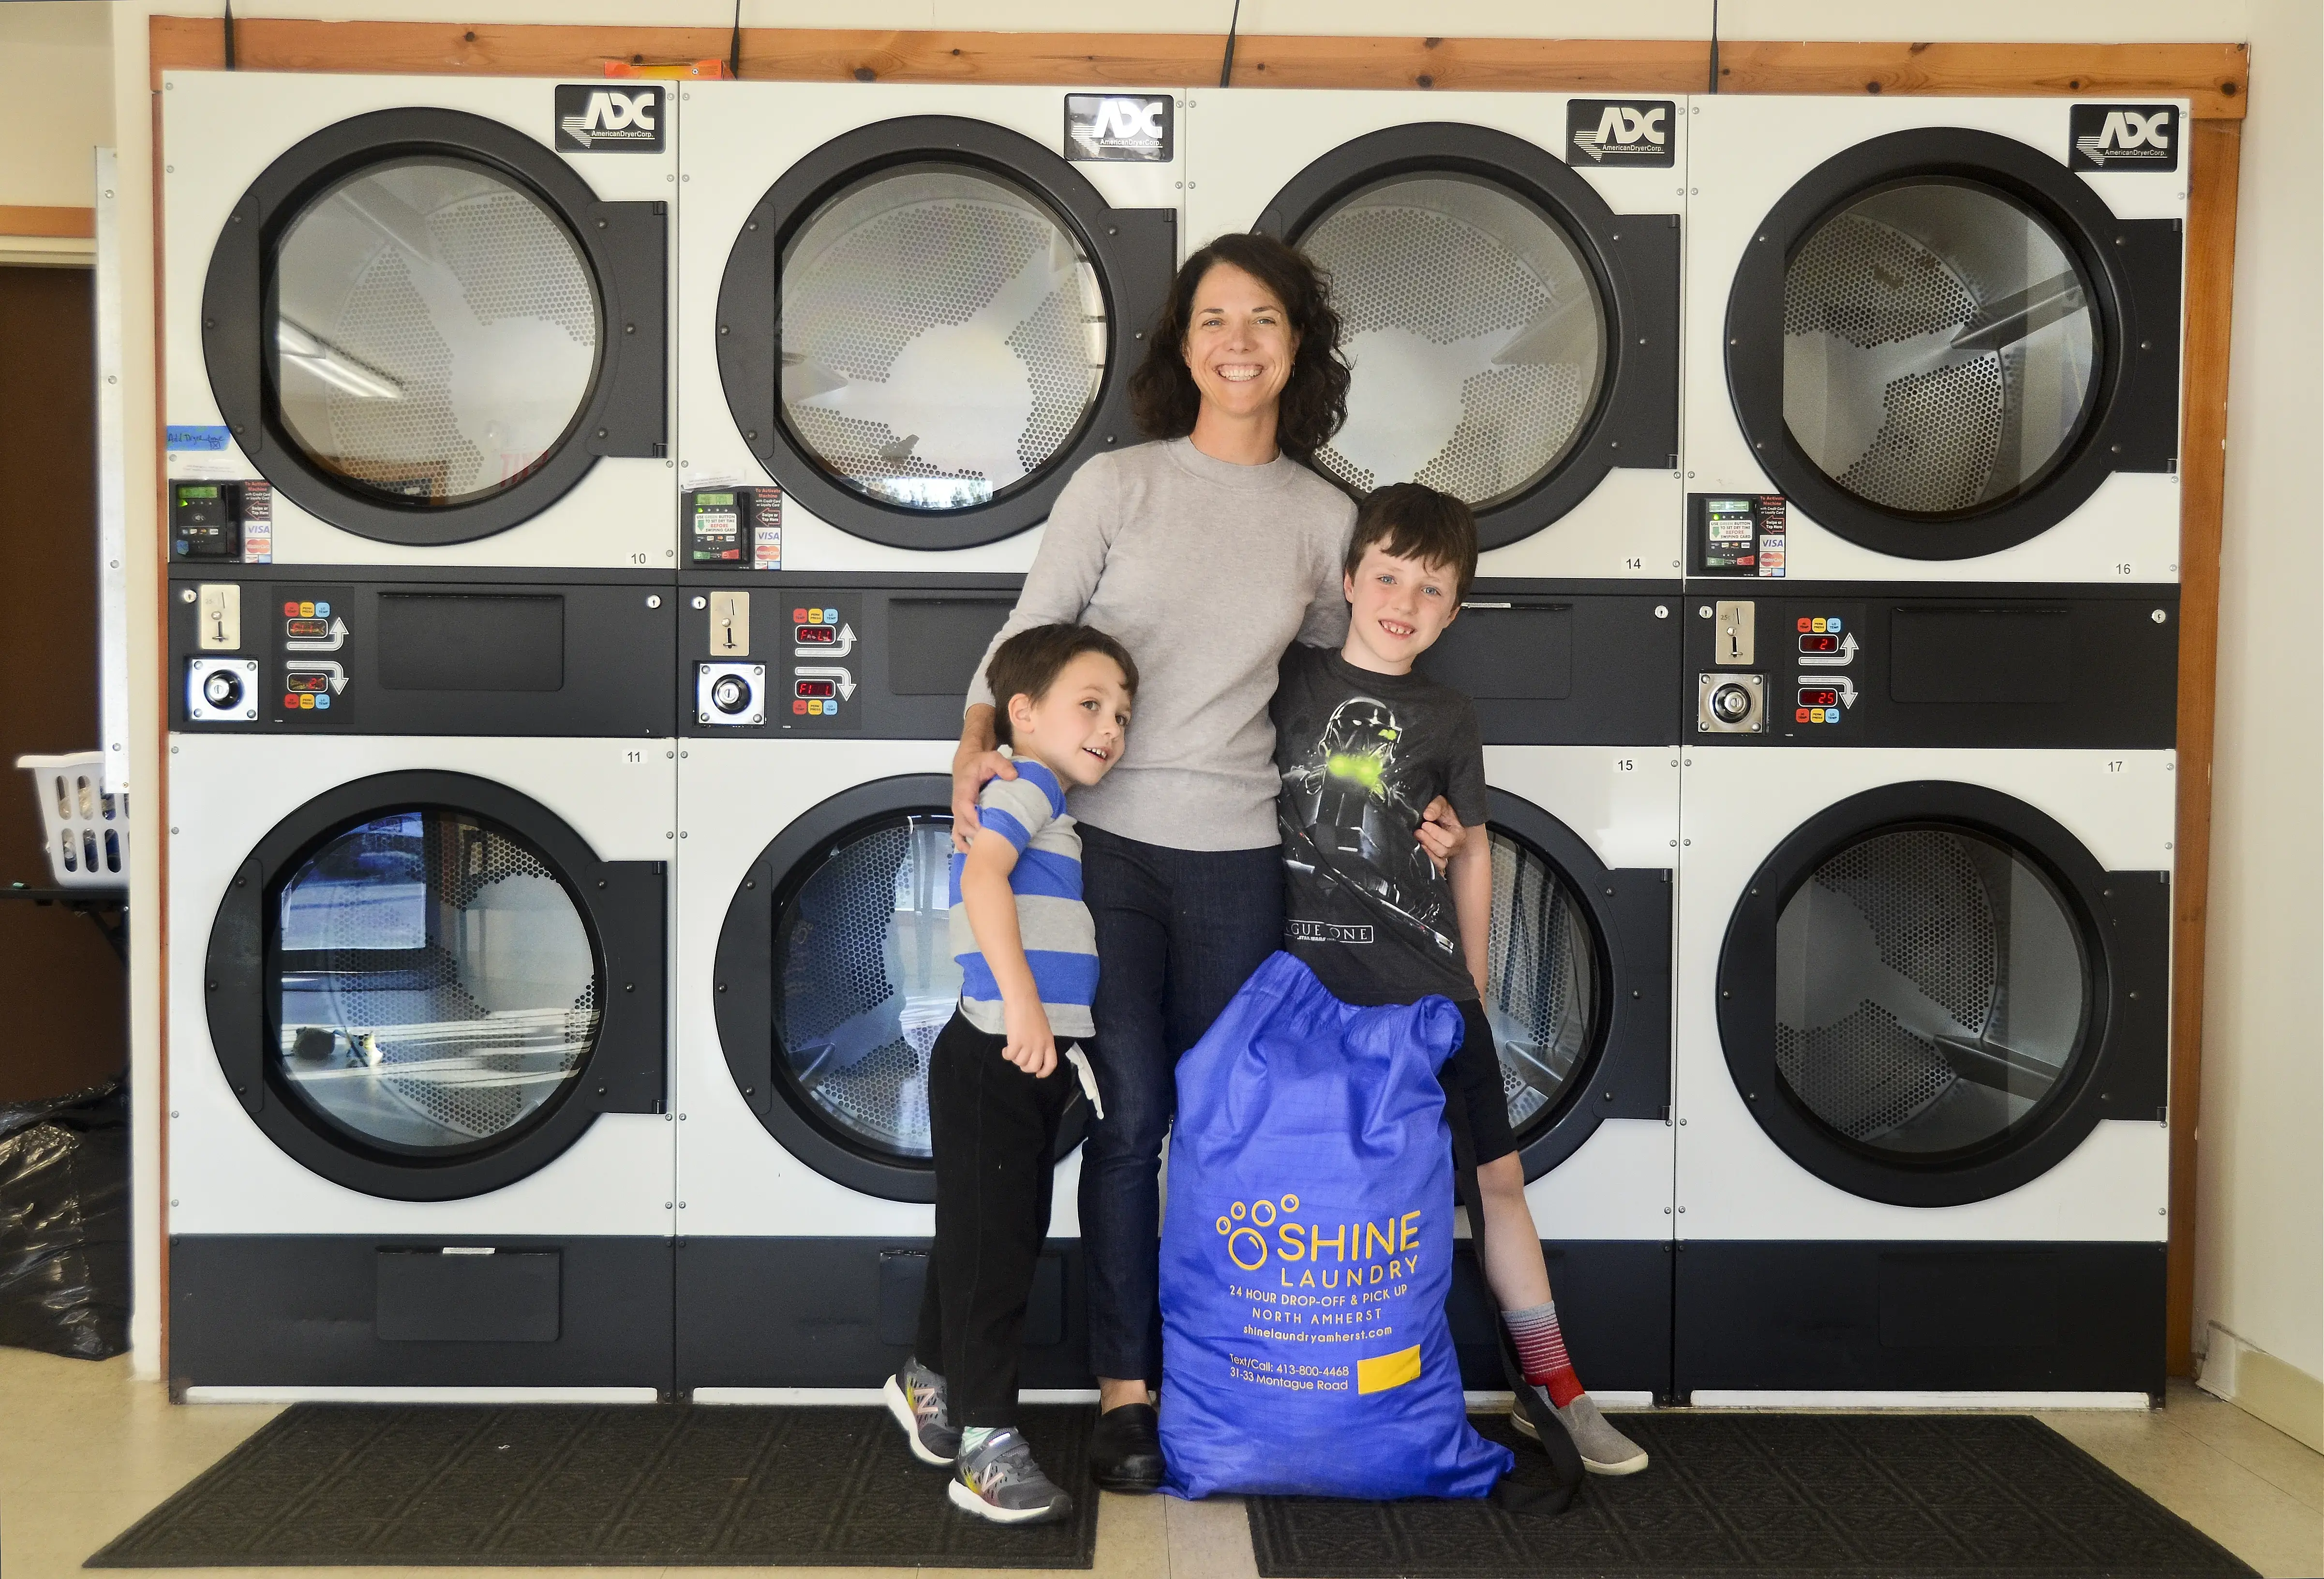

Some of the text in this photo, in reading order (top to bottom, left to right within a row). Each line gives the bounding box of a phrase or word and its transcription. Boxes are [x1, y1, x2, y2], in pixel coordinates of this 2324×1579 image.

[584, 93, 655, 130] ADC
[1092, 101, 1163, 139] ADC
[1595, 107, 1665, 144] ADC
[2098, 112, 2169, 149] ADC
[631, 553, 646, 564] 10
[1626, 558, 1641, 569] 14
[2115, 564, 2130, 574] 16
[1820, 639, 1827, 650] 2
[1819, 693, 1833, 703] 25
[627, 751, 640, 762] 11
[1618, 760, 1633, 771] 15
[2108, 761, 2122, 772] 17
[1287, 923, 1367, 940] GUE ONE
[1278, 1210, 1420, 1262] SHINE
[1281, 1255, 1417, 1288] LAUNDRY
[1230, 1284, 1407, 1307] 24 HOUR DROP-OFF & PICK UP
[1252, 1308, 1381, 1325] NORTH AMHERST
[1243, 1324, 1392, 1344] shinelaundryamherst.com
[1229, 1354, 1349, 1376] Text/Call: 413-800-4468
[1230, 1367, 1348, 1391] 31-33 Montague Road
